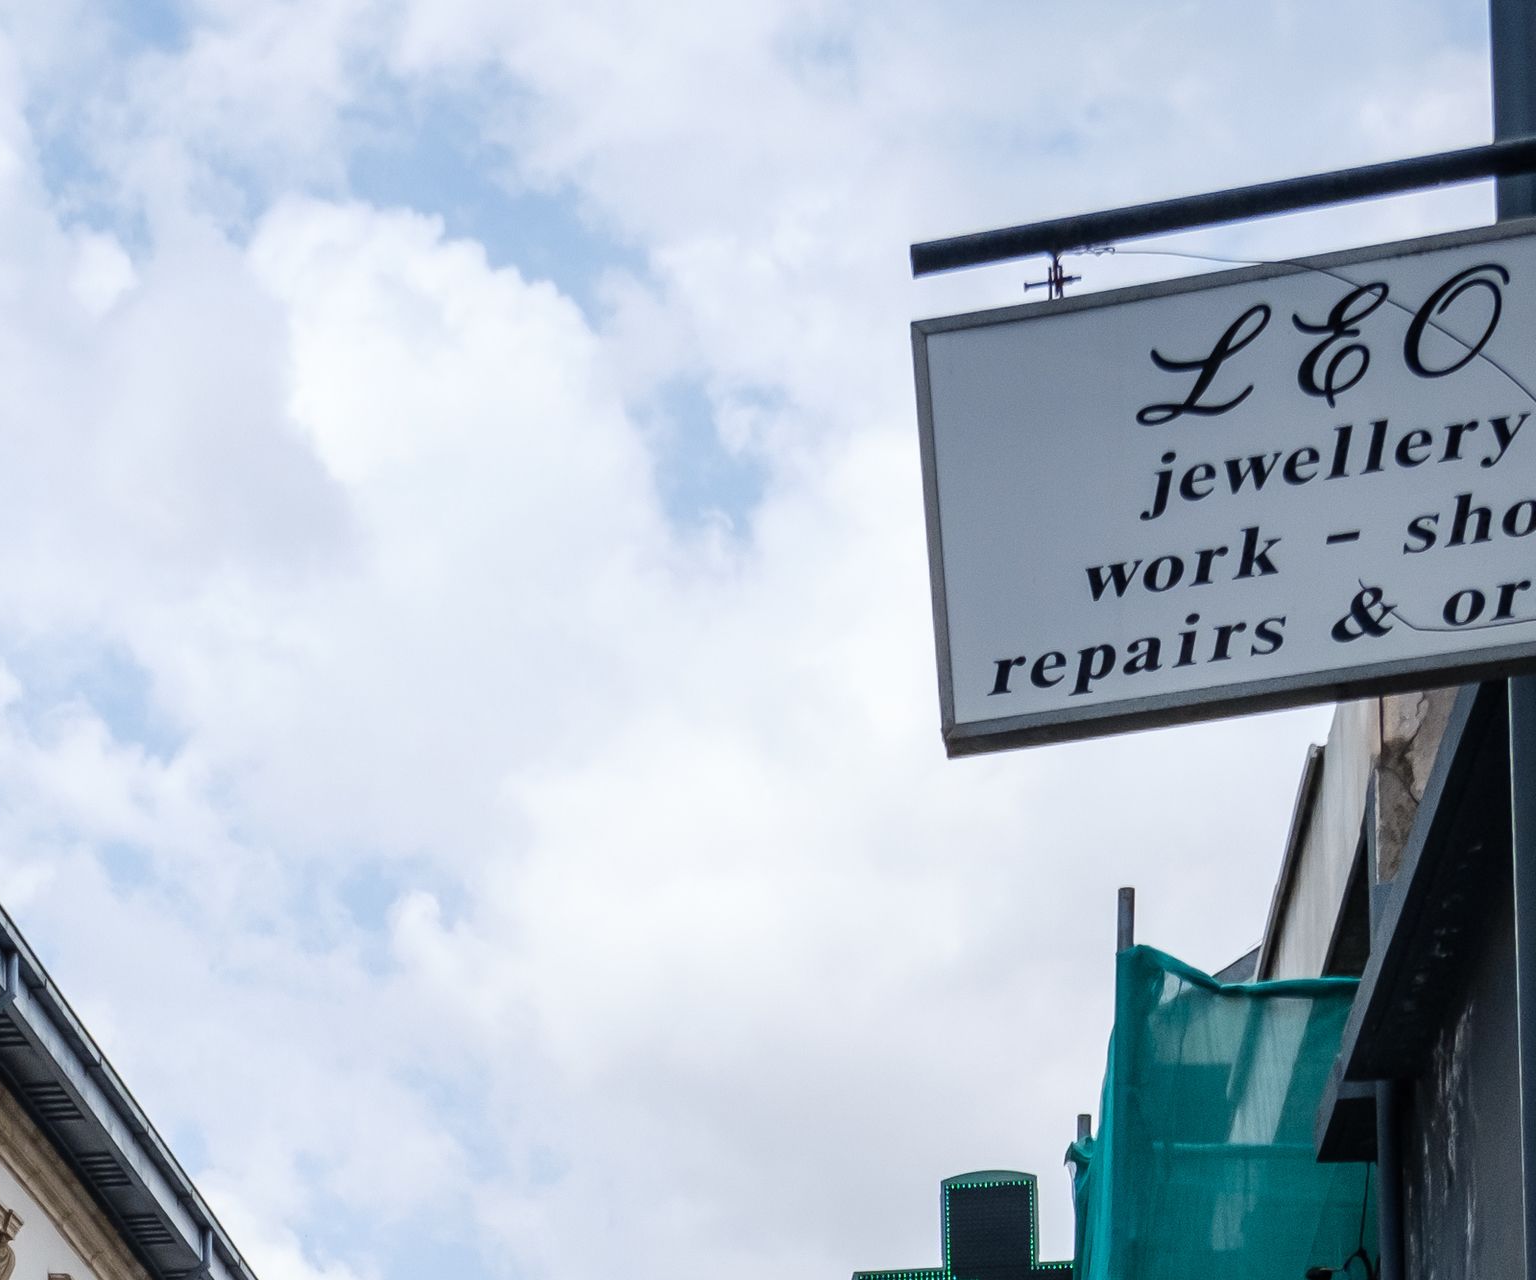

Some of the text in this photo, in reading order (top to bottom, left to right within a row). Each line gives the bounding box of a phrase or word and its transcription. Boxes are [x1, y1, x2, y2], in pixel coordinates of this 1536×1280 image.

[1136, 263, 1510, 426] LEO
[1140, 411, 1531, 521] jewellery
[1085, 526, 1282, 602] work
[1403, 493, 1536, 555] sho
[987, 579, 1532, 696] repairs & or
